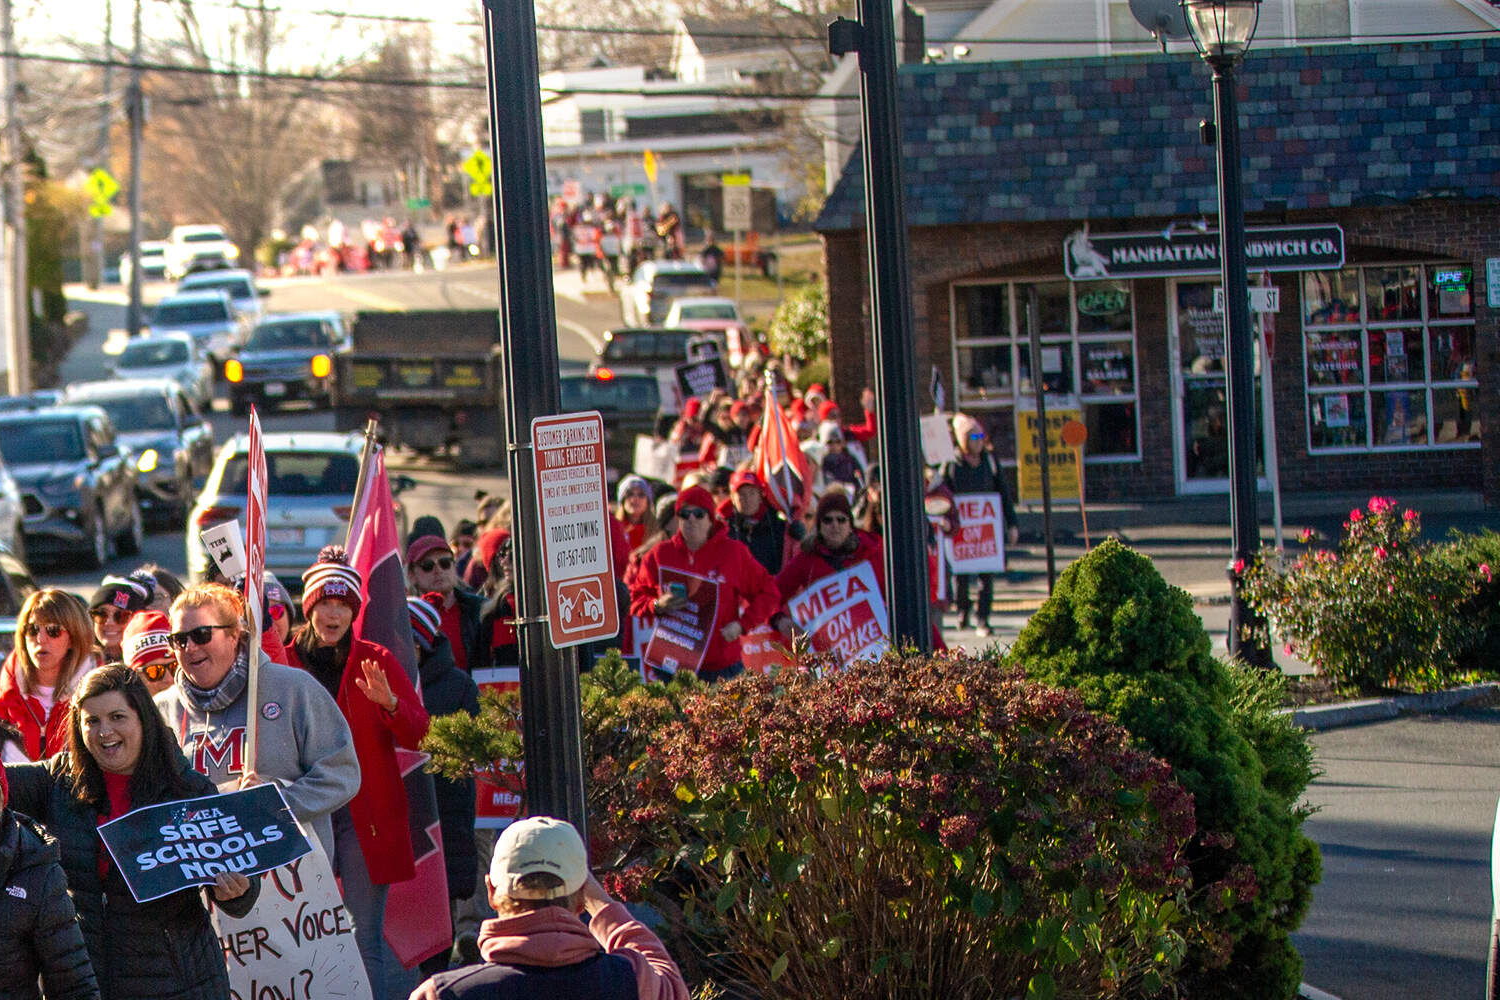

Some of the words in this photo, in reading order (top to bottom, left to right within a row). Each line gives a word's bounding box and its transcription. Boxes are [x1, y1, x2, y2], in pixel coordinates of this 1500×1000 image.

[1112, 244, 1216, 264] MANHATTAN
[1310, 239, 1338, 256] CO.
[1266, 291, 1277, 308] ST
[537, 429, 562, 447] CUSTOMER
[564, 426, 585, 444] PARKING
[587, 425, 599, 441] ONLY
[544, 449, 566, 468] TOWING
[566, 446, 596, 466] ENFORCED
[551, 523, 576, 543] TODISCO
[576, 520, 599, 539] TOWING
[795, 575, 871, 627] MEA
[827, 608, 852, 641] ON
[188, 806, 225, 822] MEA
[159, 815, 243, 842] SAFE
[135, 824, 284, 871] SCHOOLS
[179, 851, 259, 880] NOW
[281, 901, 351, 948] VOICE
